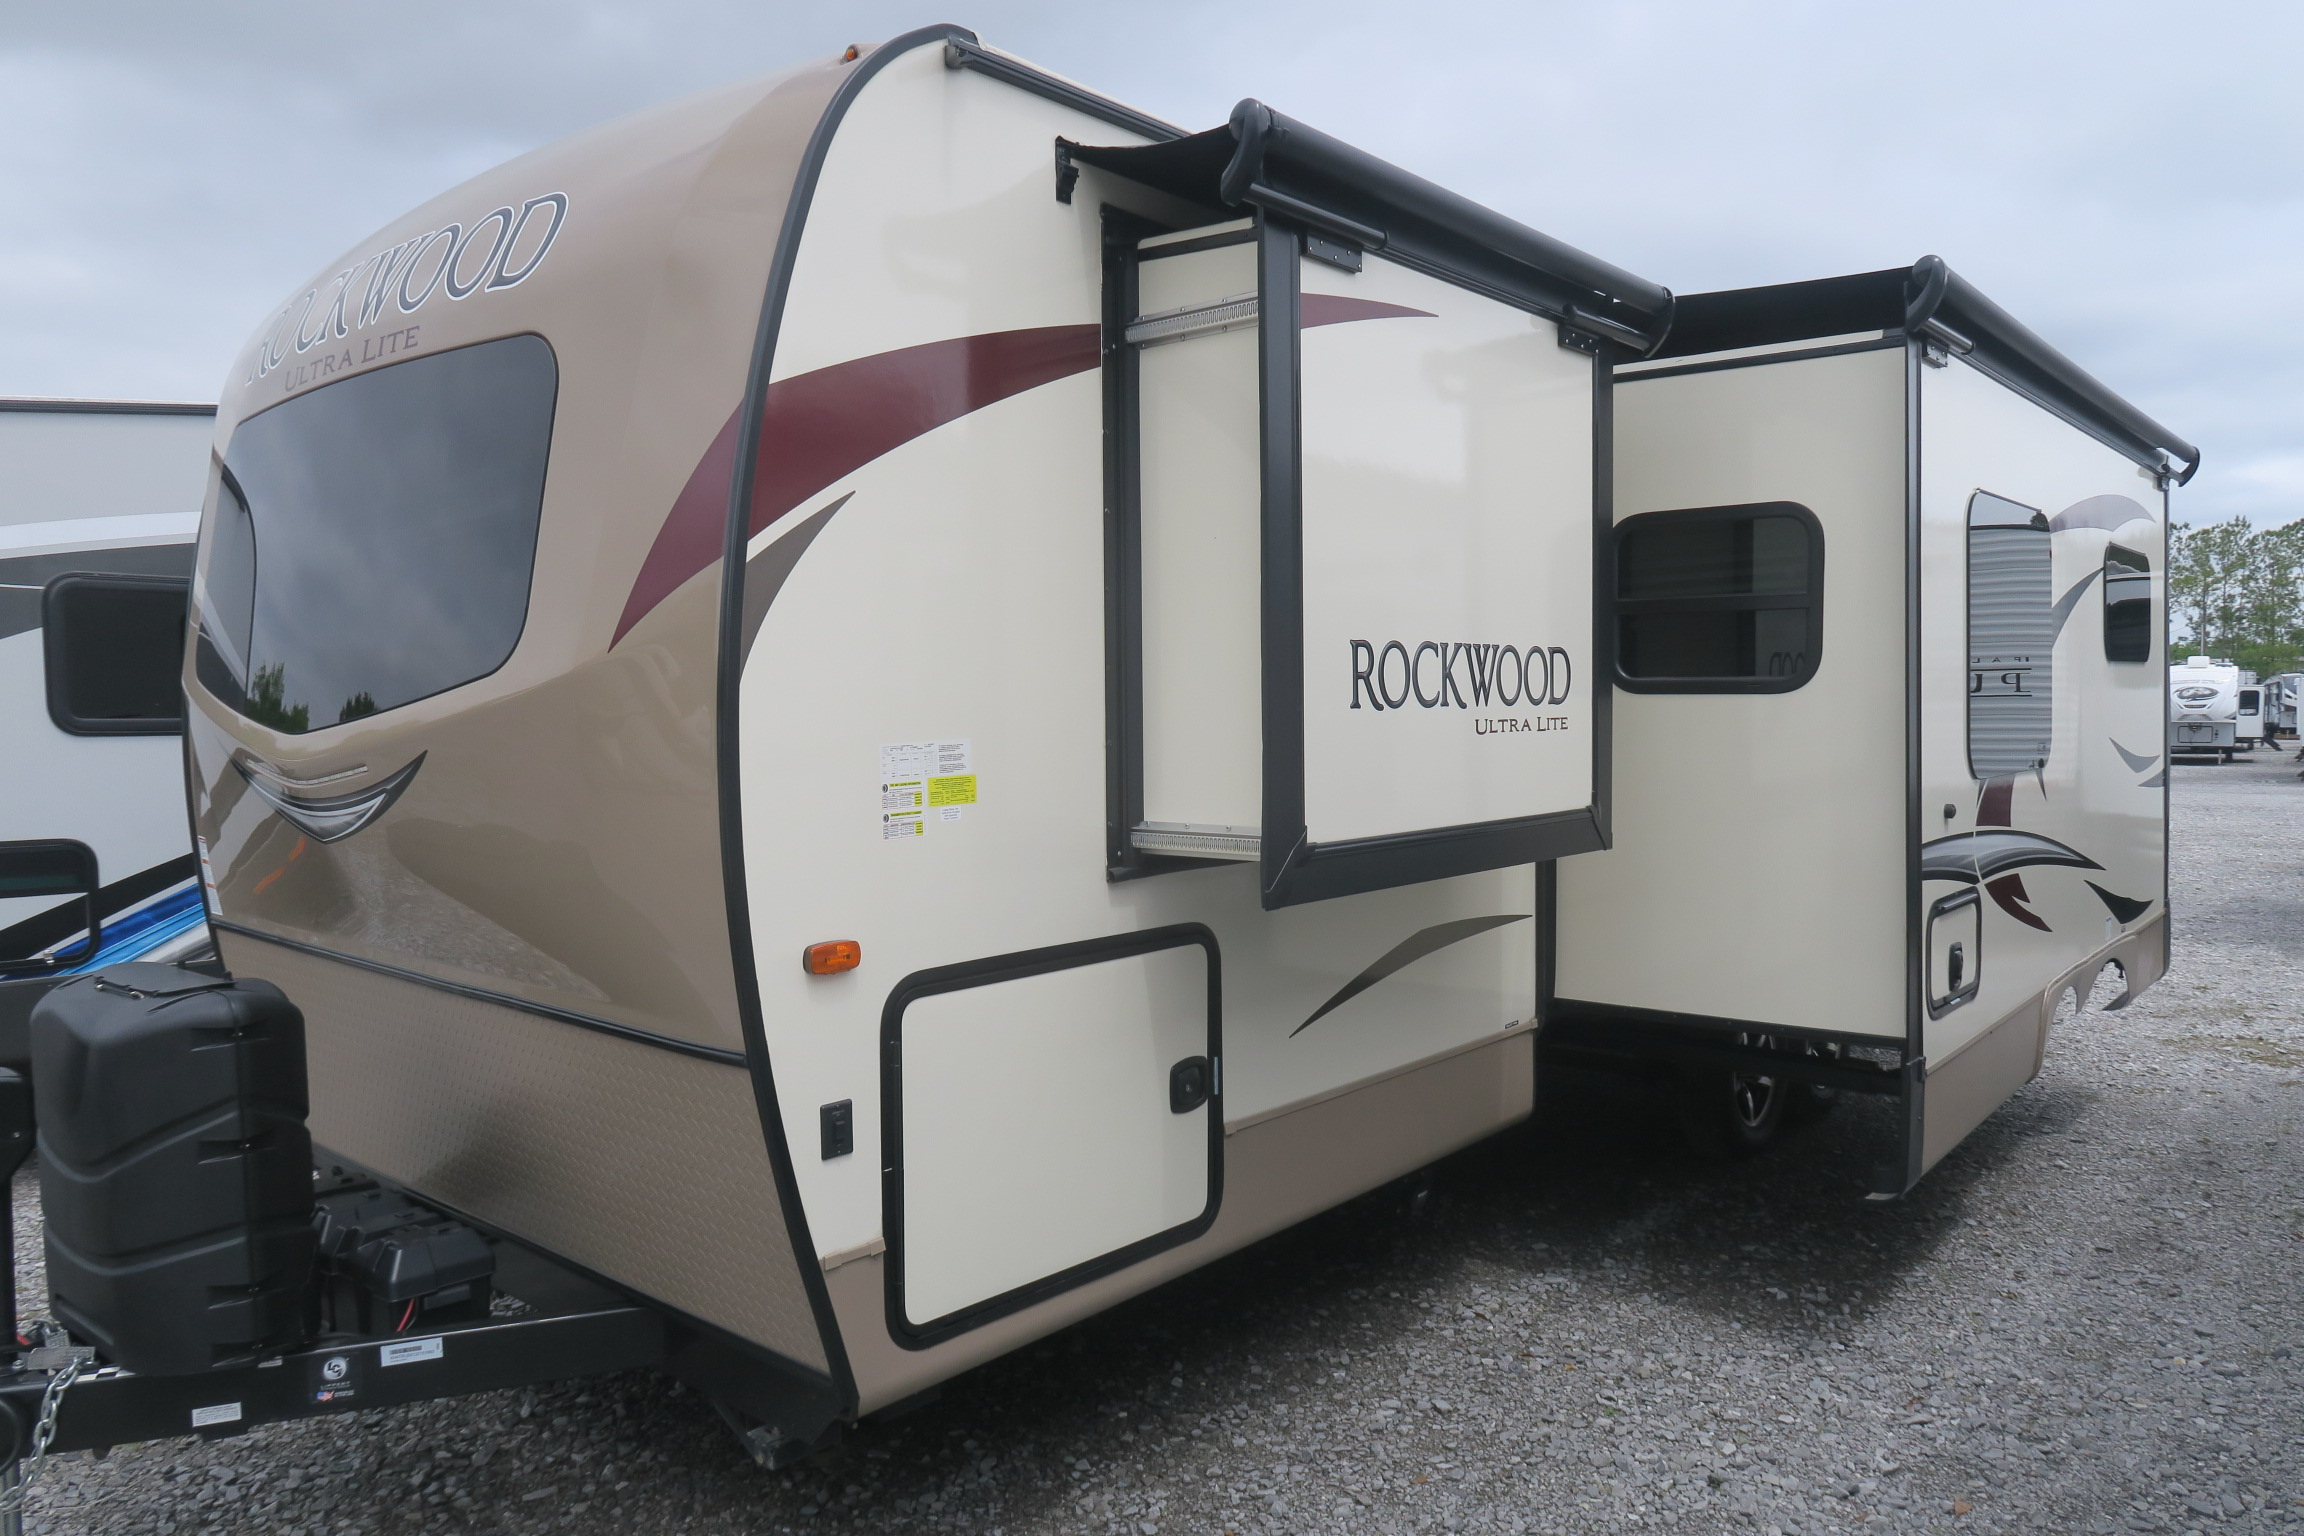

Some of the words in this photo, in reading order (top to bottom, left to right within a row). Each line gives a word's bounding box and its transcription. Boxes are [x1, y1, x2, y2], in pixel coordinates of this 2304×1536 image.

[284, 348, 354, 393] ULTRA
[360, 325, 421, 364] LITE
[1350, 639, 1572, 711] ROCKWOOD
[1474, 718, 1532, 735] ULTRA
[1536, 716, 1569, 732] LITE
